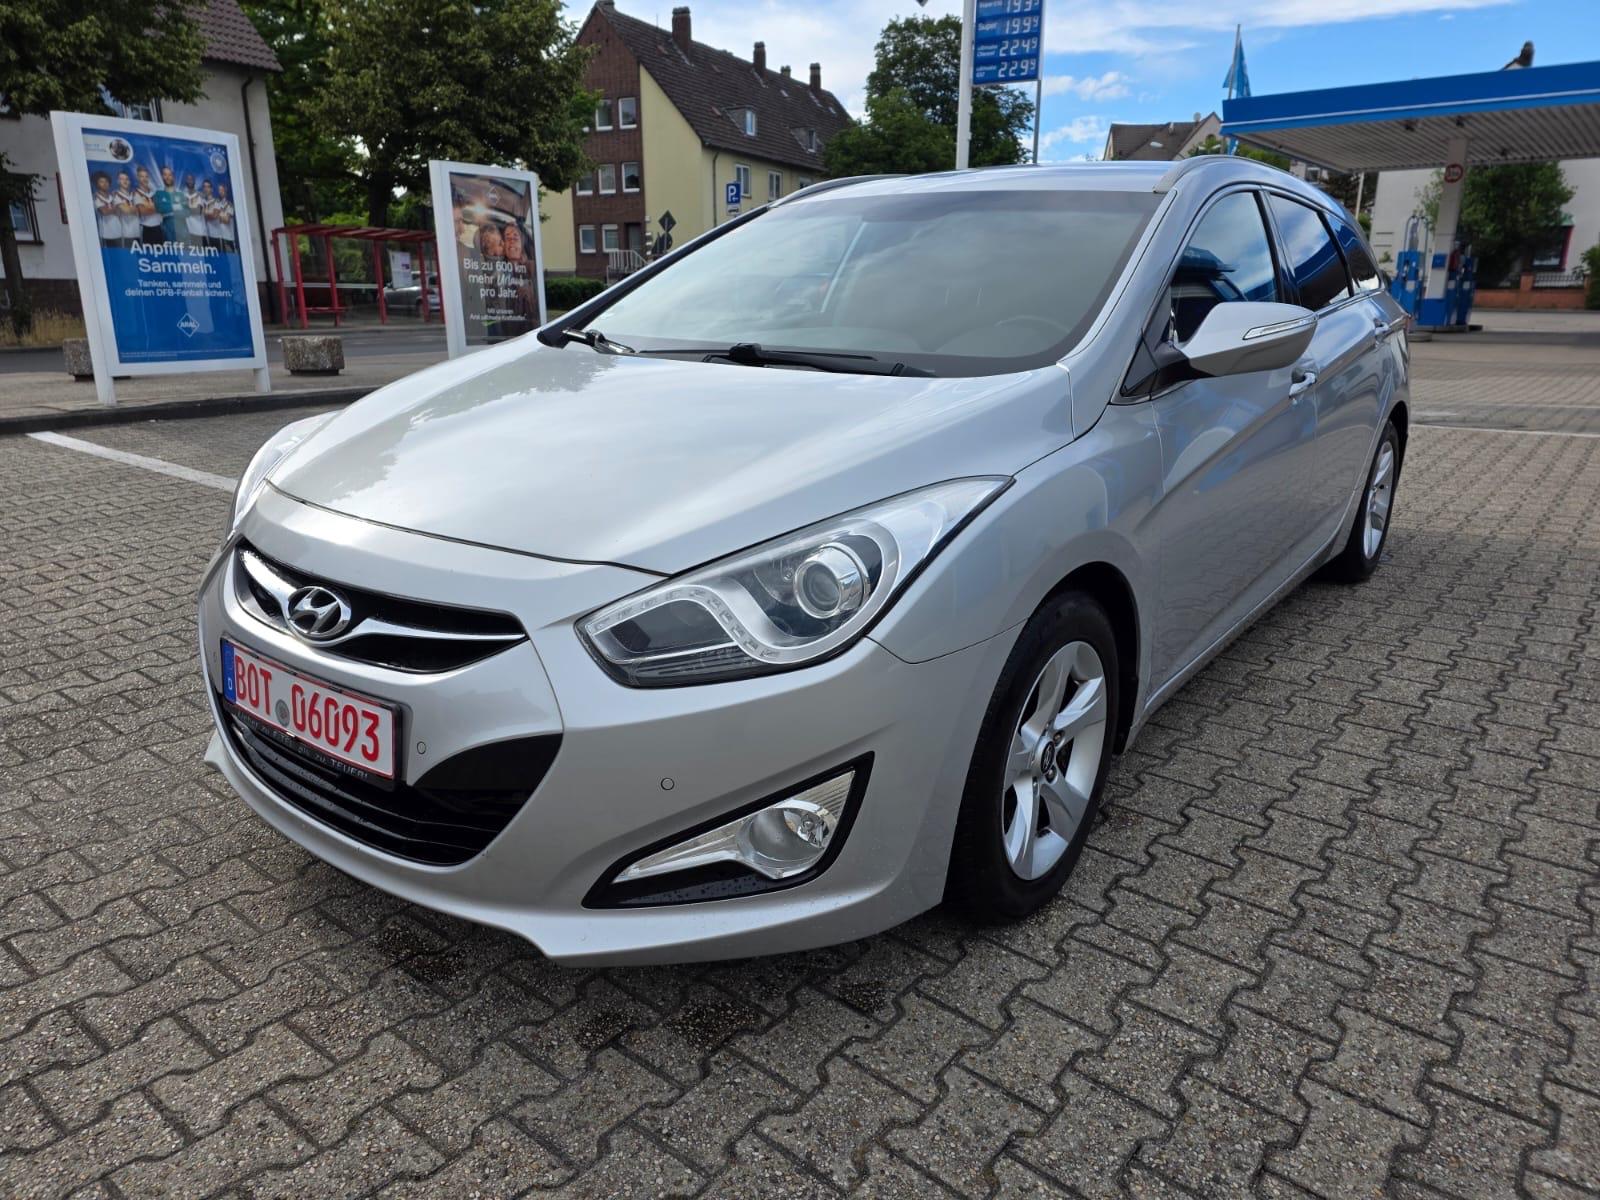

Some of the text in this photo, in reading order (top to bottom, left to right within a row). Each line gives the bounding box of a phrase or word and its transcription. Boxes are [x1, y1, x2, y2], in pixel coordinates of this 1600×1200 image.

[728, 185, 737, 202] P
[130, 240, 219, 257] Anpfiff zum
[138, 258, 217, 274] Sammeln.
[463, 258, 479, 270] Bis
[481, 262, 493, 271] zu
[468, 273, 494, 284] mehr
[480, 287, 518, 300] pro Jahr.
[235, 655, 272, 716] BOT
[291, 684, 380, 762] 06093
